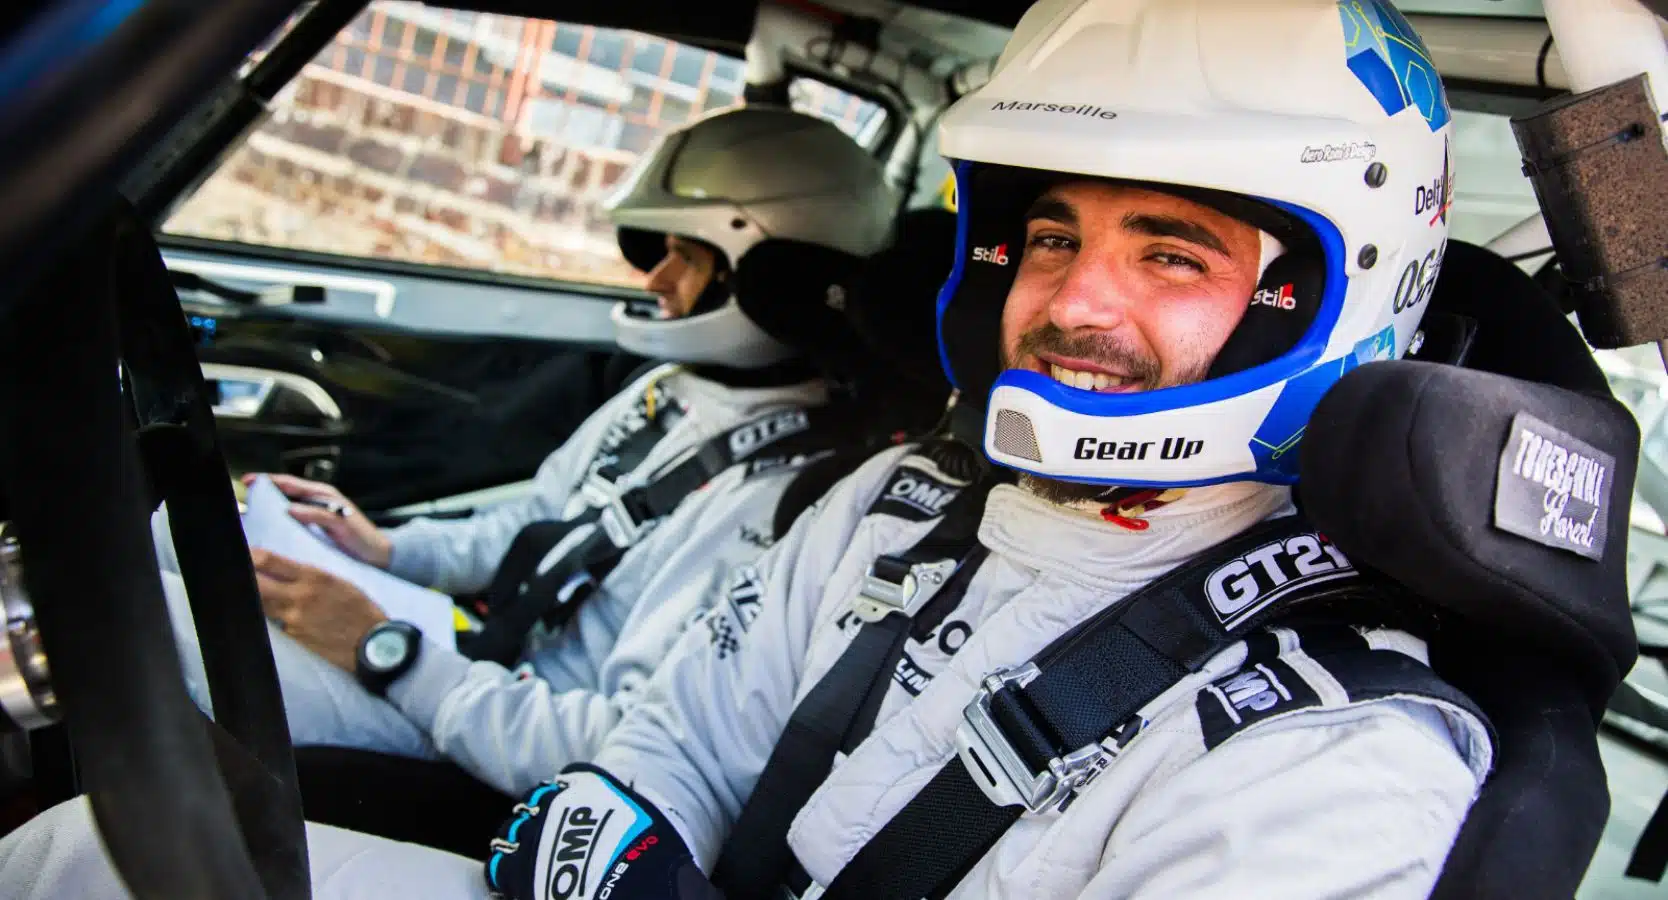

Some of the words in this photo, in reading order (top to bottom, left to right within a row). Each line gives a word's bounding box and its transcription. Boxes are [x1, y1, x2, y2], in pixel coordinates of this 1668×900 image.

[991, 101, 1118, 120] Marseille
[972, 244, 1009, 266] Stilo
[1073, 437, 1156, 460] Gear
[1160, 437, 1204, 460] Up
[1217, 671, 1278, 711] MP
[551, 806, 599, 900] OMP
